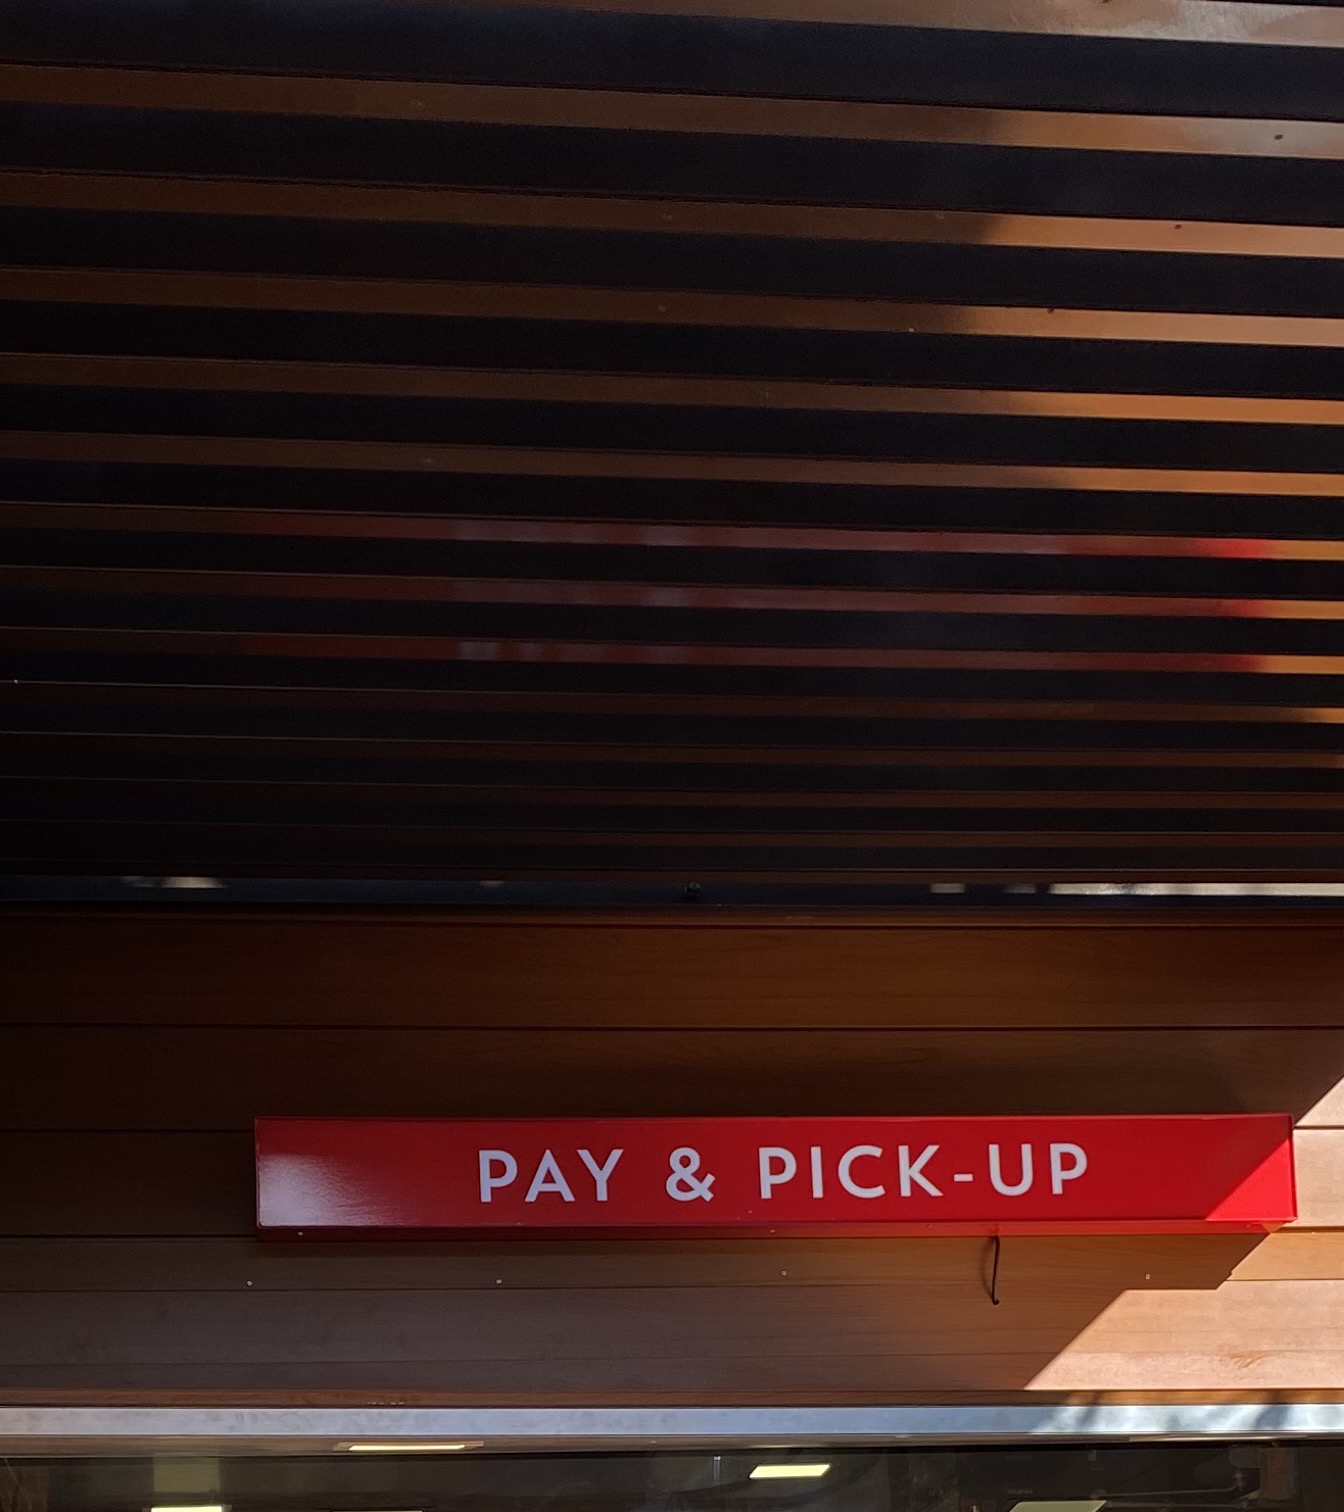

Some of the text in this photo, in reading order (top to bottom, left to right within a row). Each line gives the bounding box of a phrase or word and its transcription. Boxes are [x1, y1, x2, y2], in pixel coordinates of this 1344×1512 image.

[478, 1143, 1088, 1202] PAY & PICK-UP
